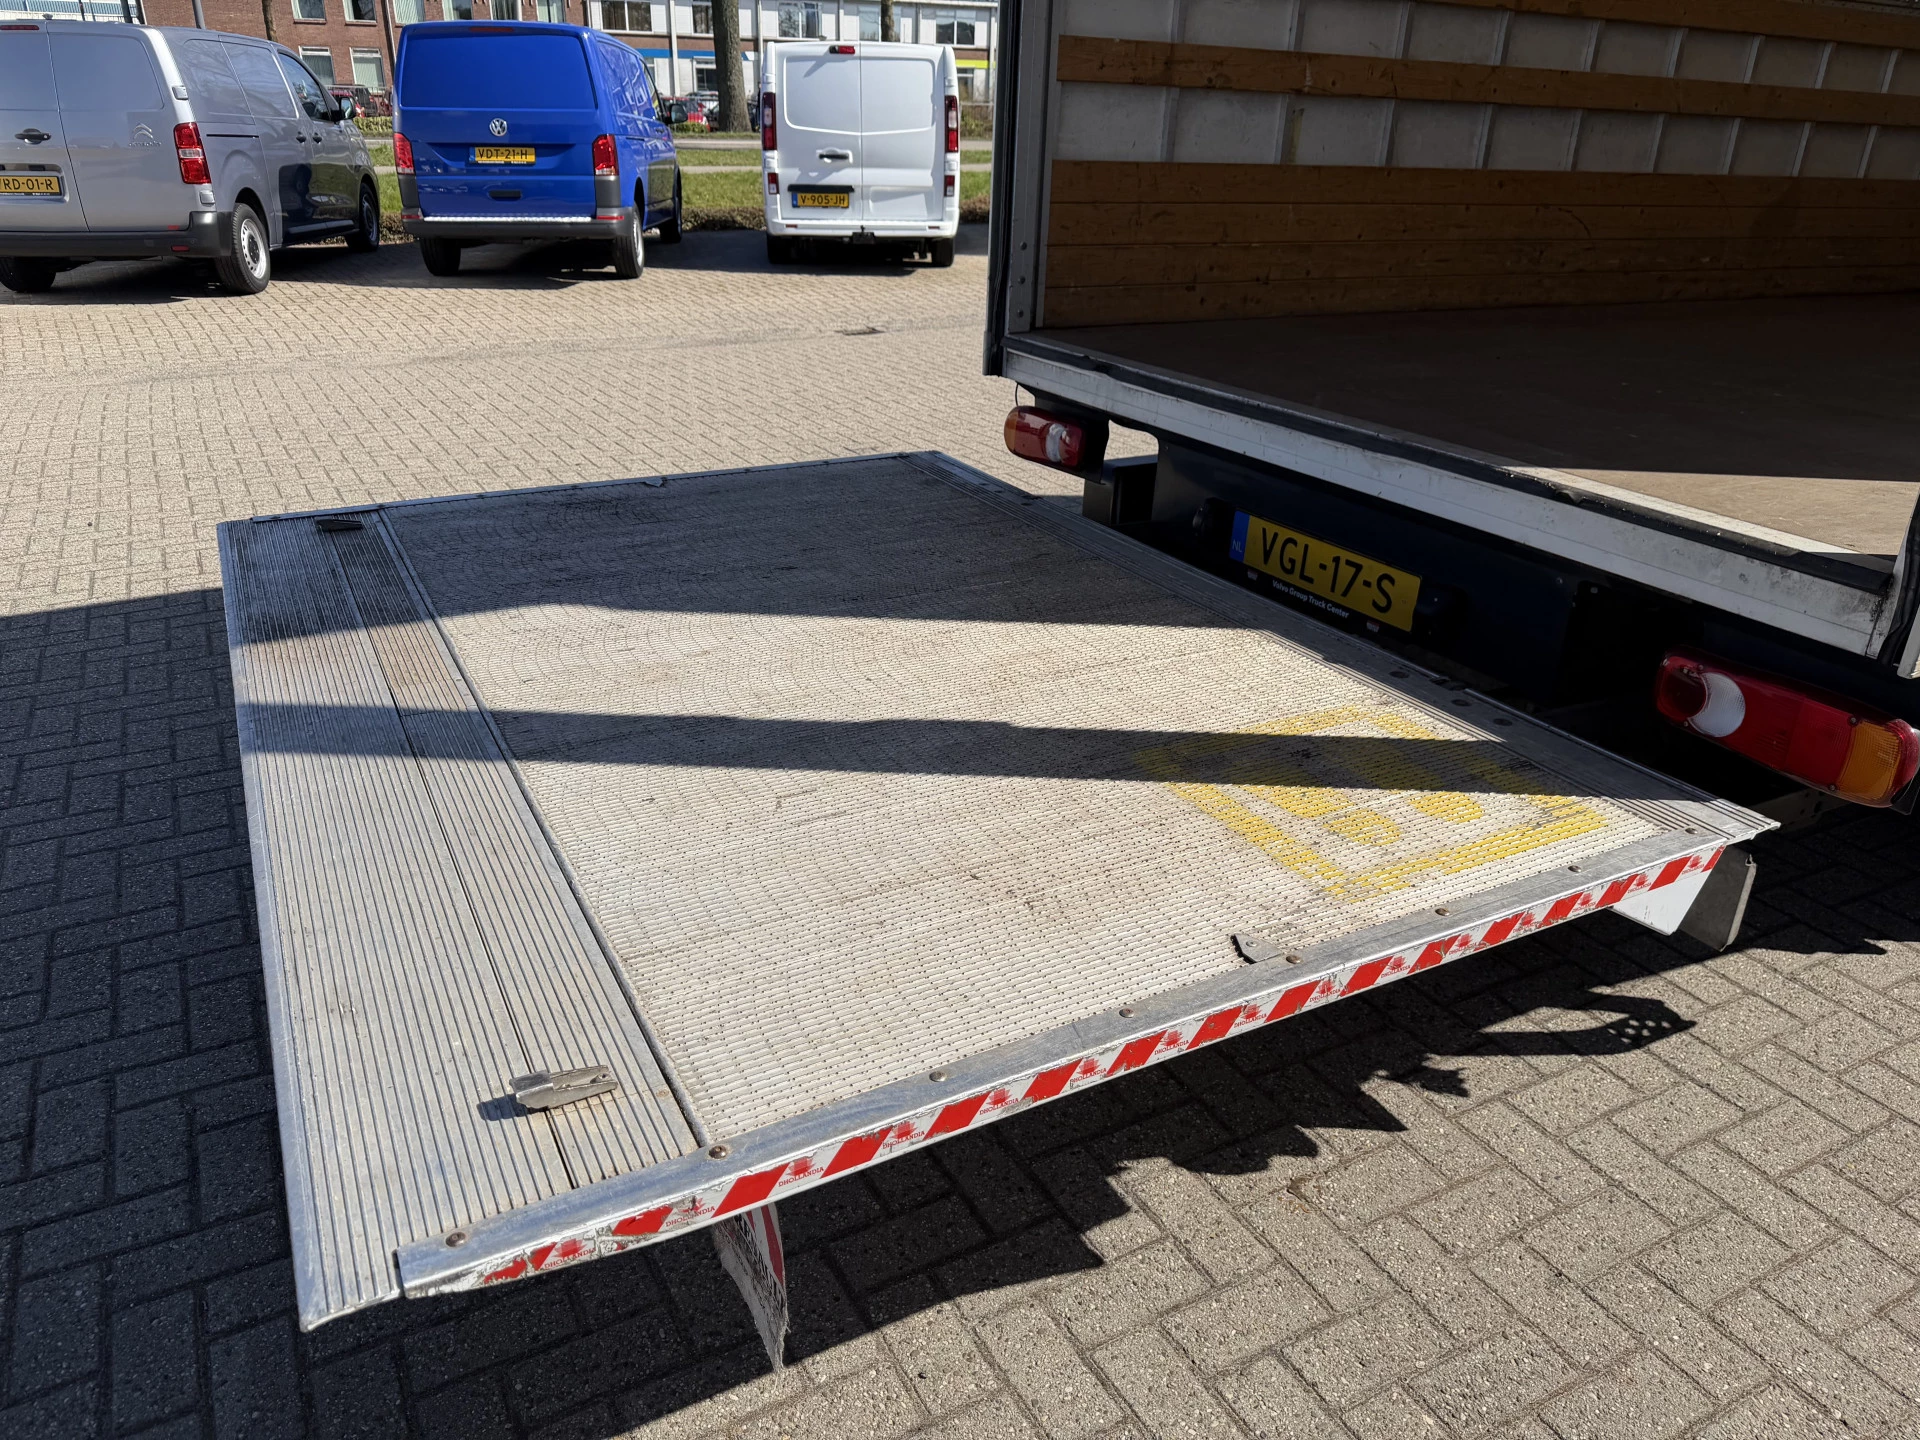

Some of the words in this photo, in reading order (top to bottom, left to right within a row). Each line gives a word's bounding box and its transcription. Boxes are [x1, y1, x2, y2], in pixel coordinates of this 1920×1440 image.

[478, 148, 528, 159] VDT-21-H
[0, 178, 54, 190] RD-01-R
[800, 194, 845, 205] V-905-JH
[1232, 539, 1243, 553] NL
[1261, 526, 1396, 614] VGL-17-S
[1272, 579, 1289, 593] Volvo
[1289, 587, 1308, 602] Group
[1308, 595, 1327, 610] Truck
[1327, 603, 1350, 619] Center
[979, 1097, 1019, 1116] DHOLLANDIA
[882, 1130, 925, 1150] DHOLLANDIA
[778, 1166, 825, 1187] DHOLLANDIA
